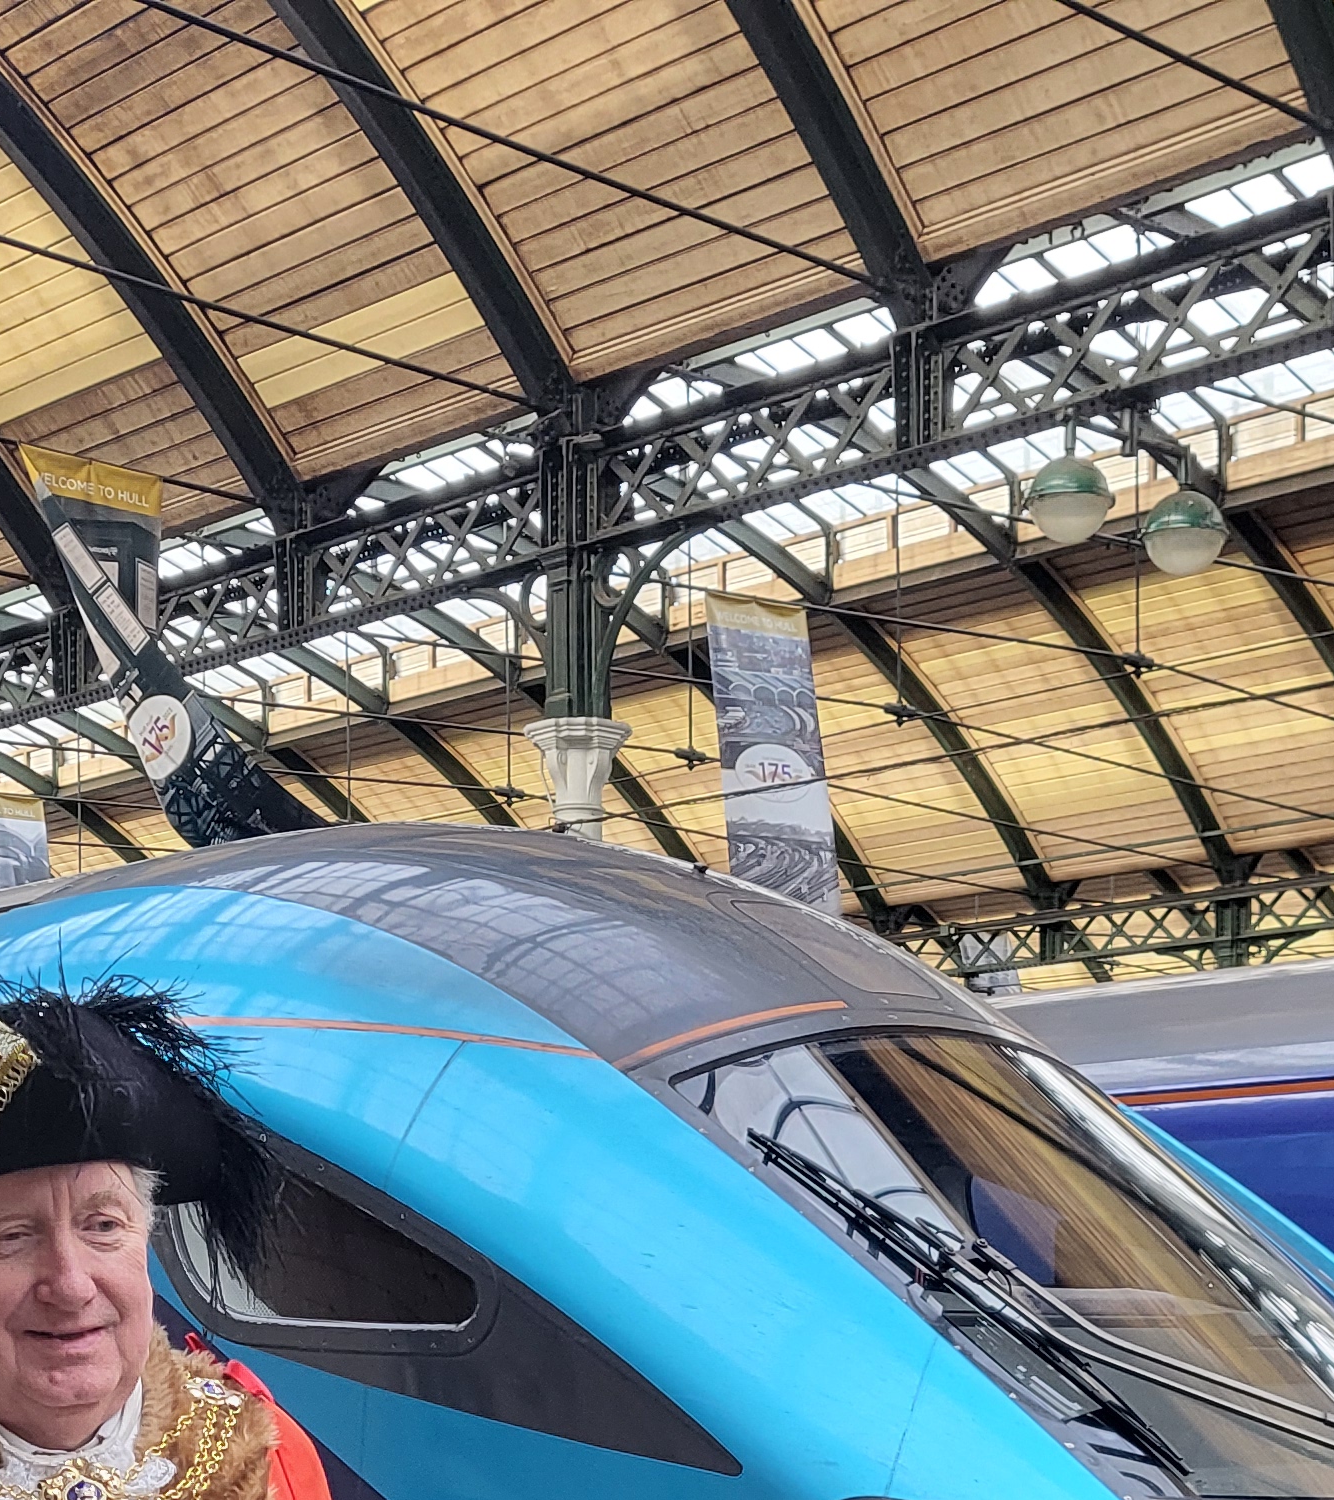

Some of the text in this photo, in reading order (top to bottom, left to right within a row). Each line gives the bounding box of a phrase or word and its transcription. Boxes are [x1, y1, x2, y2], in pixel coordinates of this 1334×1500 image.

[98, 484, 115, 499] TO
[118, 490, 150, 508] HULL
[717, 611, 760, 627] WELCOME
[761, 617, 773, 628] TO
[142, 716, 170, 755] 175
[758, 762, 793, 783] 175
[3, 807, 14, 815] TO
[15, 809, 36, 818] HULL
